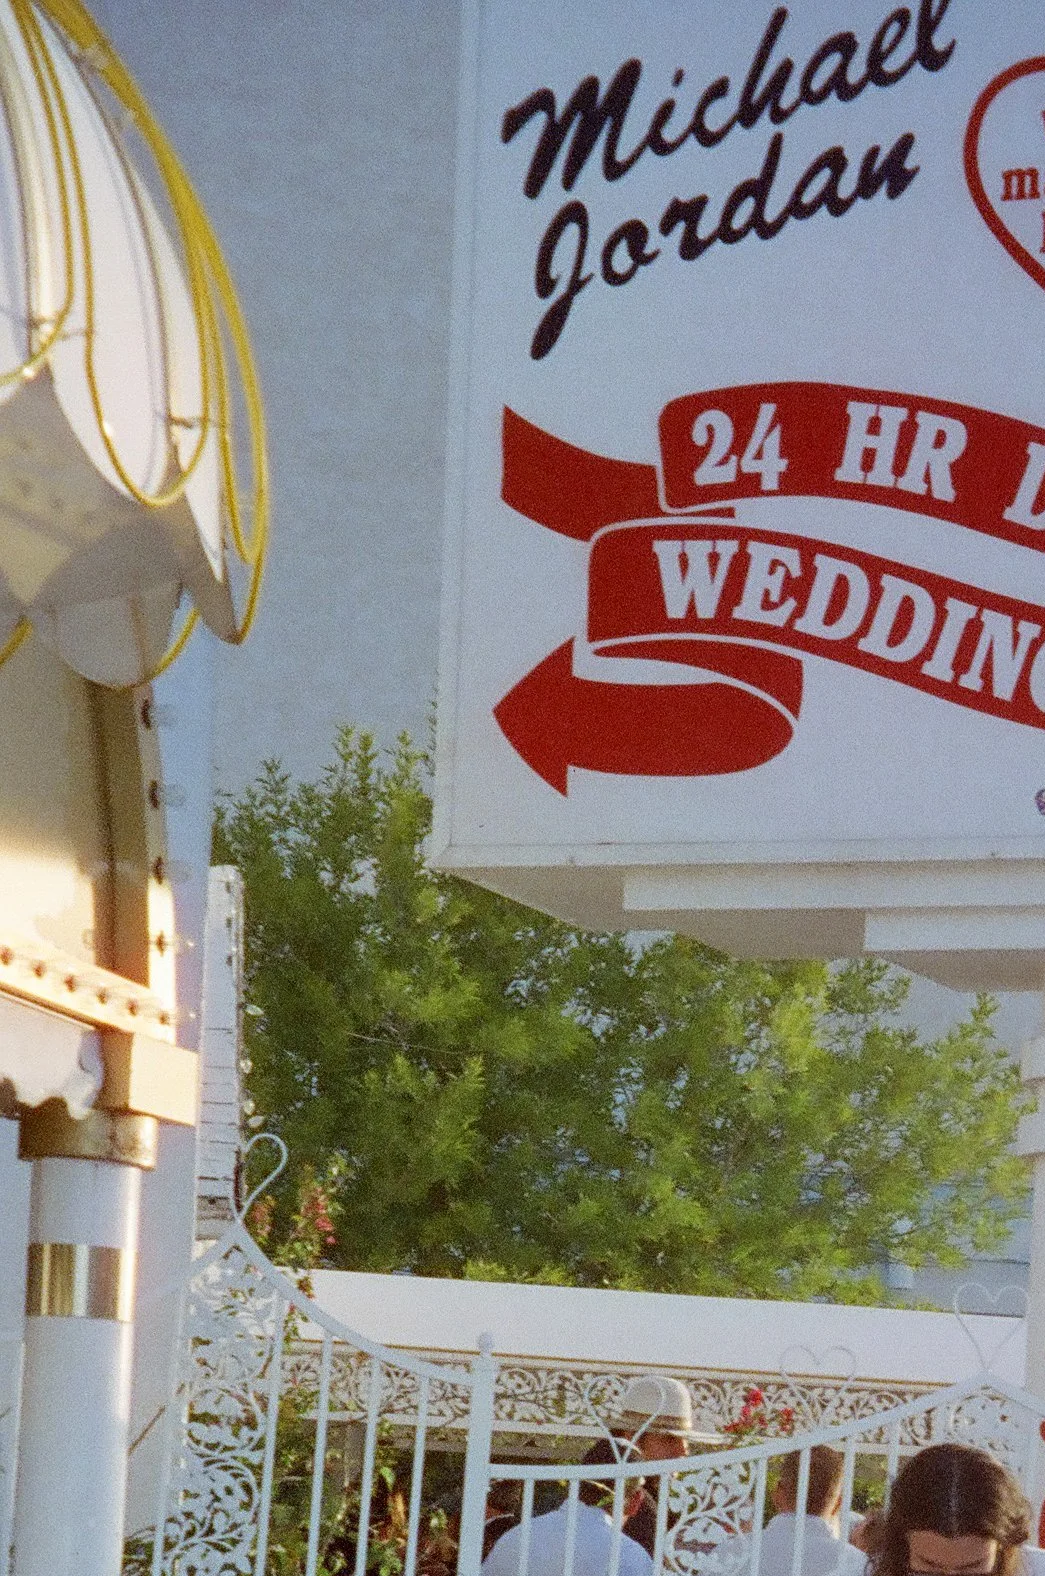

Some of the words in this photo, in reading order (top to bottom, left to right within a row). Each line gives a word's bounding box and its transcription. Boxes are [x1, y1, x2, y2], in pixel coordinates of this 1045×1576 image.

[501, 0, 956, 198] Michael
[530, 132, 920, 360] Jordan
[692, 402, 788, 491] 24
[834, 400, 968, 502] HR
